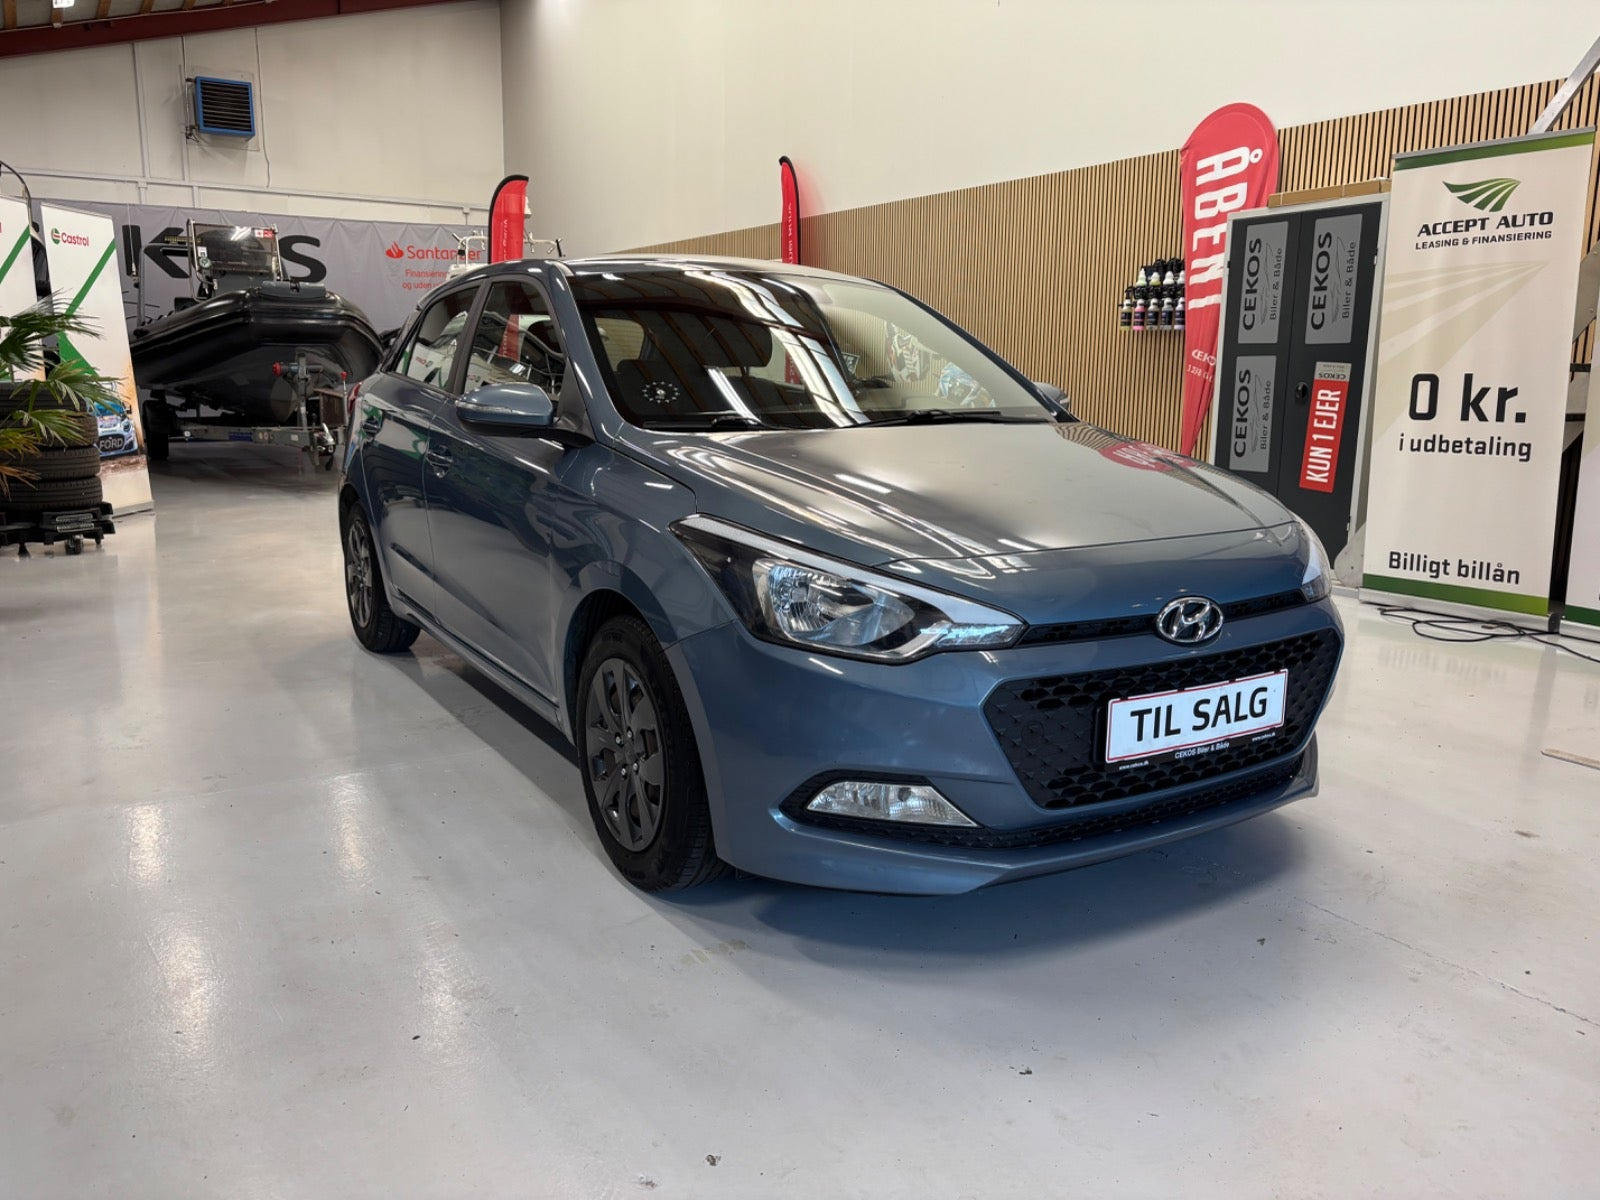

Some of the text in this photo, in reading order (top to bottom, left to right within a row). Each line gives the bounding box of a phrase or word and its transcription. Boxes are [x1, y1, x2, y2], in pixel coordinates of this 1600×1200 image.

[61, 232, 90, 247] Castrol
[1417, 211, 1554, 237] ACCEPT AUTO
[407, 245, 482, 260] Santaner
[1415, 231, 1552, 250] LEASING & FINANSIERING
[1274, 248, 1282, 277] Både
[1243, 238, 1262, 330] CEKOS
[1273, 281, 1279, 290] &
[1311, 232, 1332, 330] CEKOS
[1342, 242, 1356, 318] Biler & Både
[1318, 372, 1346, 380] CEKOS
[1234, 369, 1251, 458] CEKOS
[1313, 389, 1341, 429] EJER
[1409, 373, 1526, 423] 0 kr.
[1260, 381, 1271, 450] Biler & Både
[99, 437, 123, 449] FORD
[1399, 433, 1532, 462] i udbetaling
[1306, 446, 1333, 483] KUN
[1388, 551, 1520, 584] Billigt billån
[1130, 687, 1268, 742] TIL SALG
[1175, 748, 1196, 759] CEKOS
